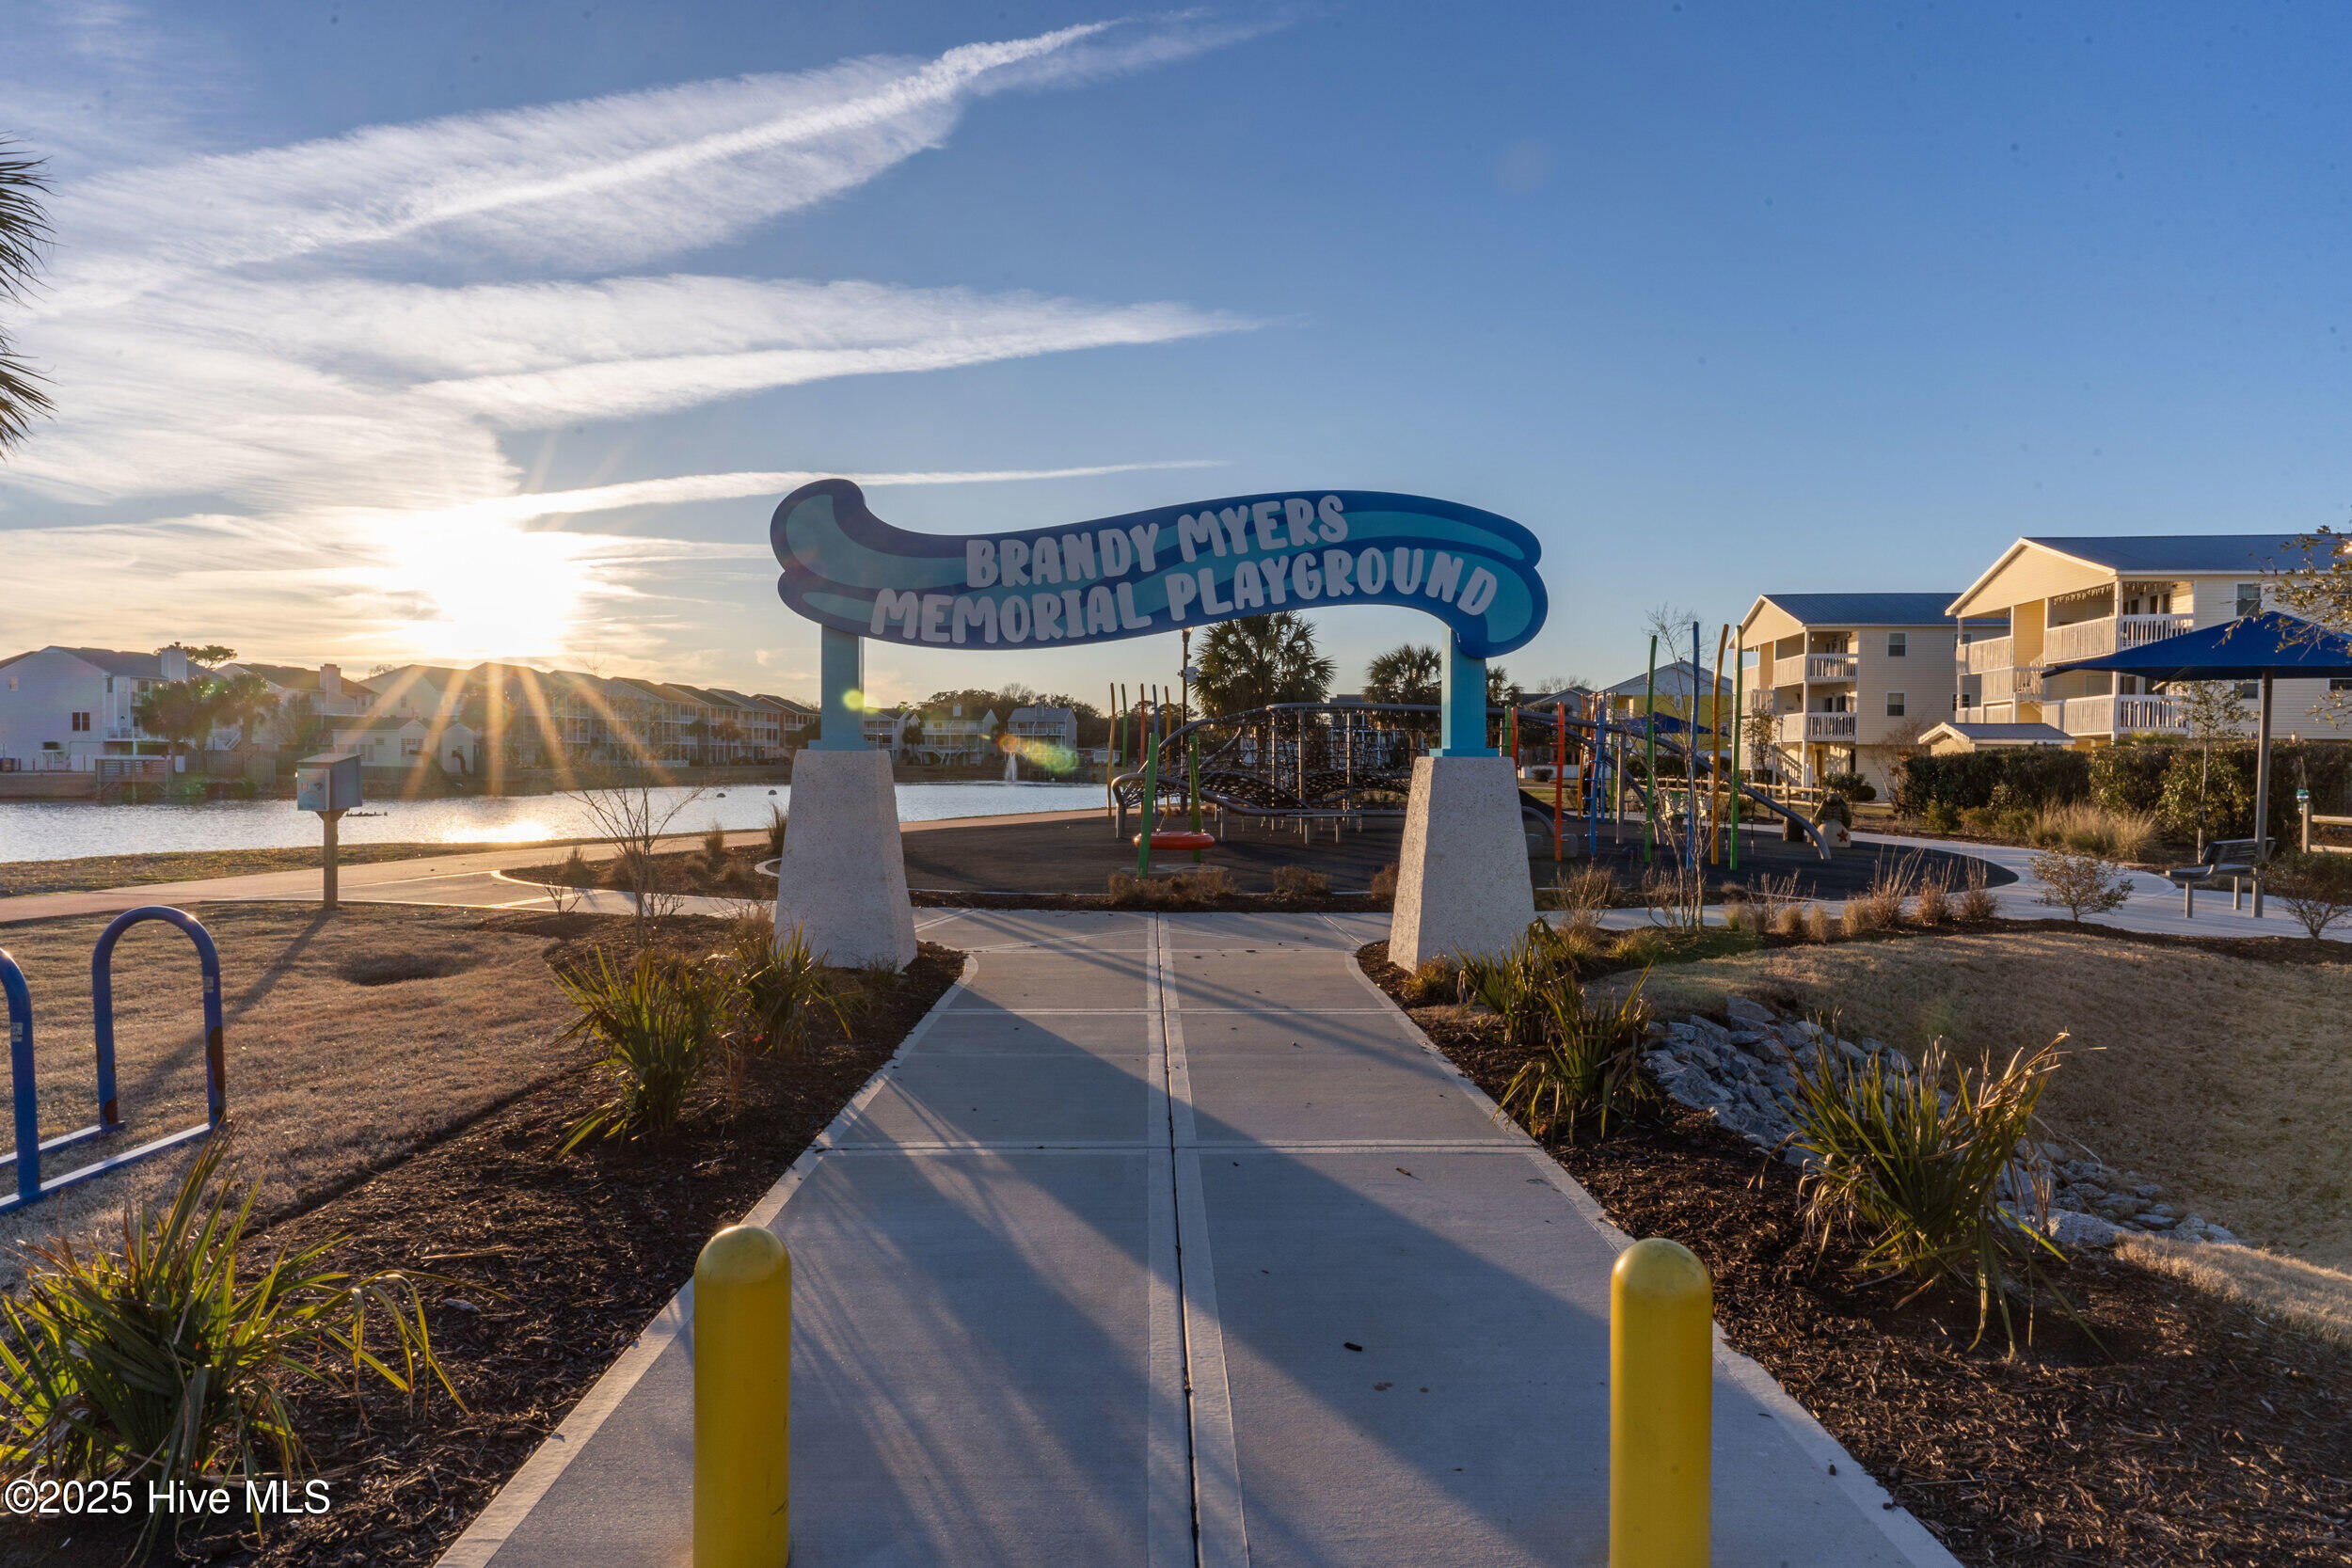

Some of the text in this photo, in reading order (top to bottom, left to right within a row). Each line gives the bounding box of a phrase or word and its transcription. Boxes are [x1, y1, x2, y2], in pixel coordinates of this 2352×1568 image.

[966, 495, 1349, 588] BRANDY MYERS
[870, 546, 1498, 643] MEMORIAL PLAYGROUND
